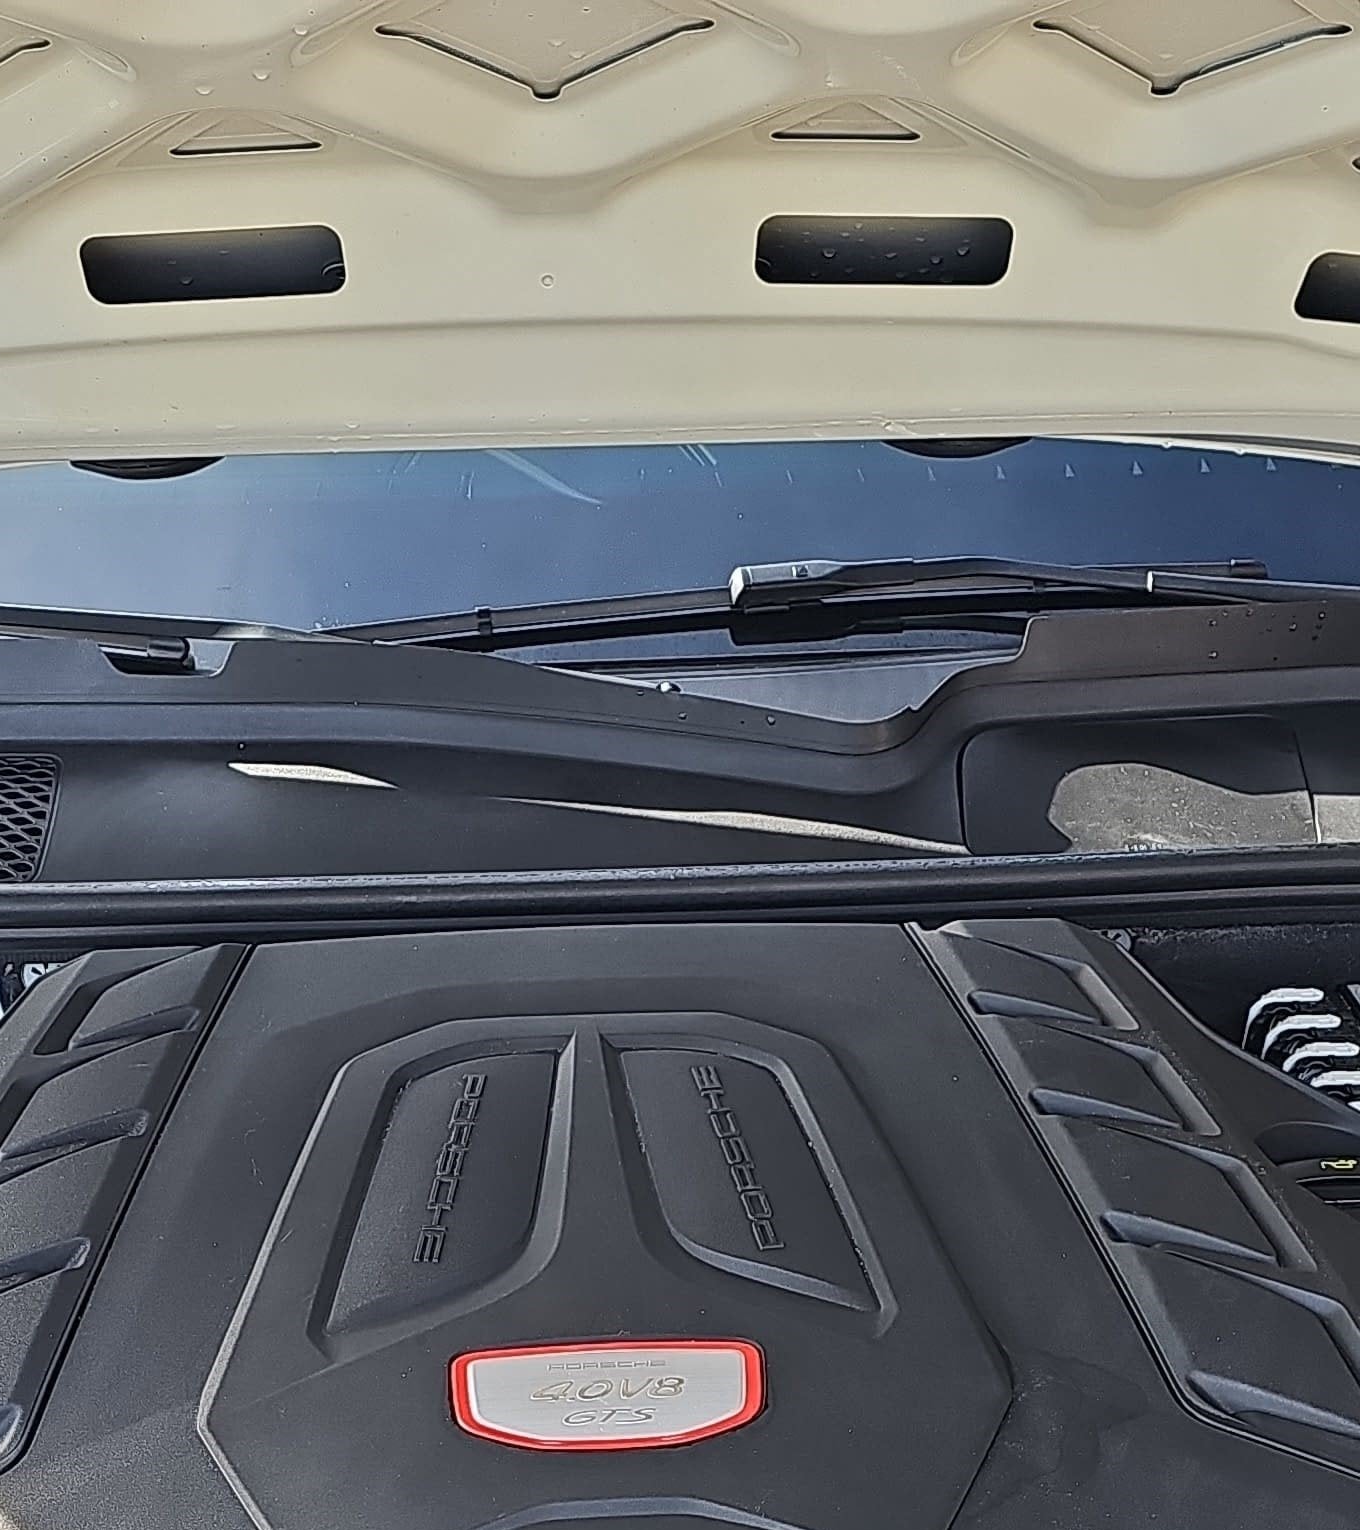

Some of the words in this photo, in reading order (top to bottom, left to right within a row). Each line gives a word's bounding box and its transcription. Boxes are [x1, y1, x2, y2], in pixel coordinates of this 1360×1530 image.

[413, 1073, 488, 1263] PORSCHE
[689, 1065, 786, 1251] PORSCHE
[561, 1407, 657, 1427] GTS
